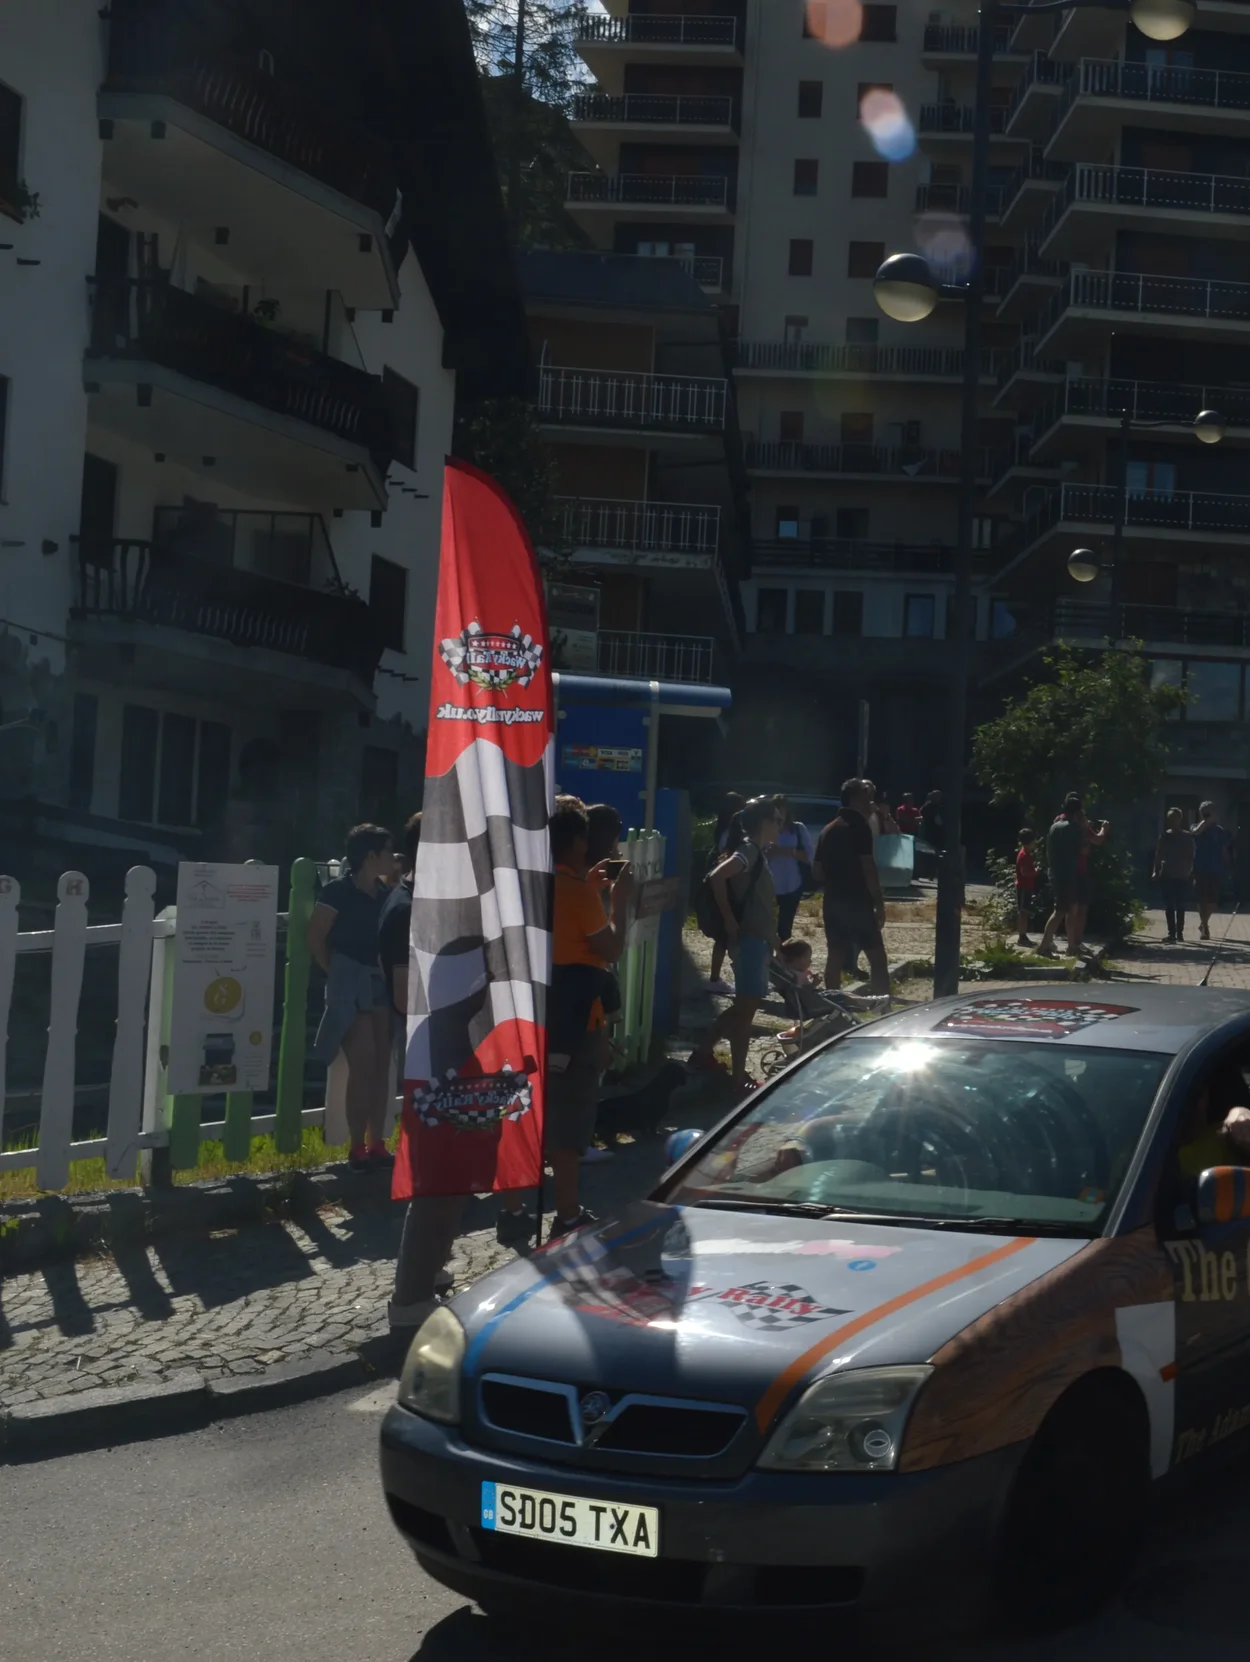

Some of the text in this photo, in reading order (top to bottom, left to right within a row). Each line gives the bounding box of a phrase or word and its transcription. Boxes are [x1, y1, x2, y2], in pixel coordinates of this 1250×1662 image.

[1165, 1238, 1237, 1302] The
[718, 1287, 824, 1315] Rally
[483, 1508, 494, 1521] GB
[500, 1490, 652, 1550] SD05 TXA
